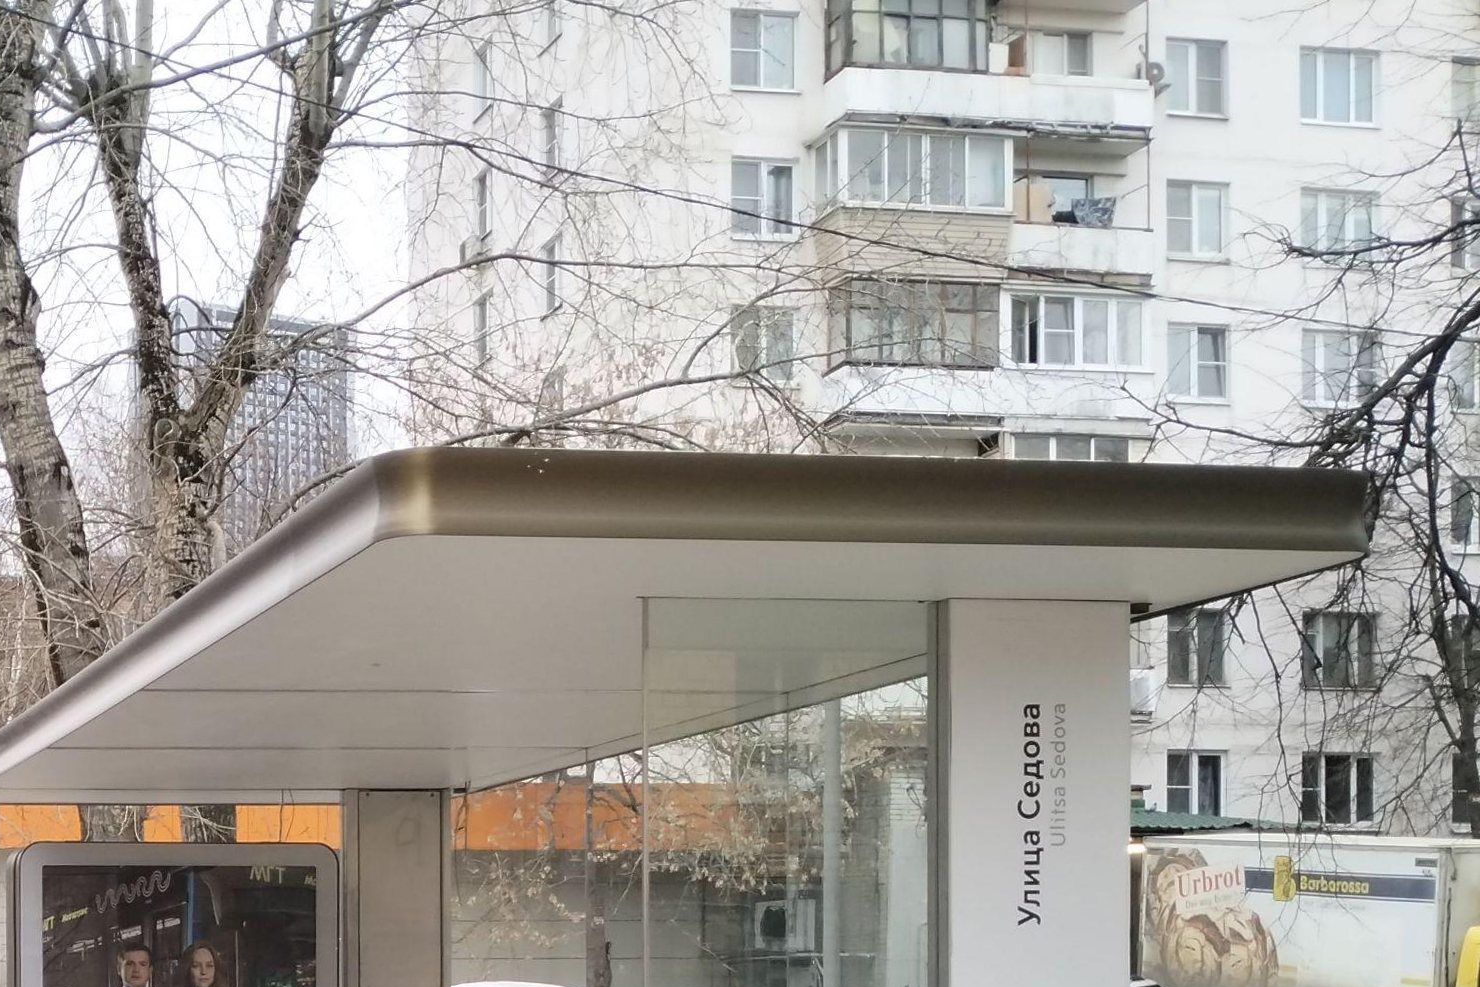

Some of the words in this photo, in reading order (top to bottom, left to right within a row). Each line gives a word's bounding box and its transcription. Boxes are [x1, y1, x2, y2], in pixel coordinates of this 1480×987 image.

[1017, 703, 1044, 819] Седова
[1050, 703, 1067, 780] Sedova
[1050, 786, 1067, 847] Ulitsa
[1017, 830, 1044, 926] Улица
[1178, 865, 1242, 899] Urbrot
[1299, 875, 1369, 894] Barbarossa
